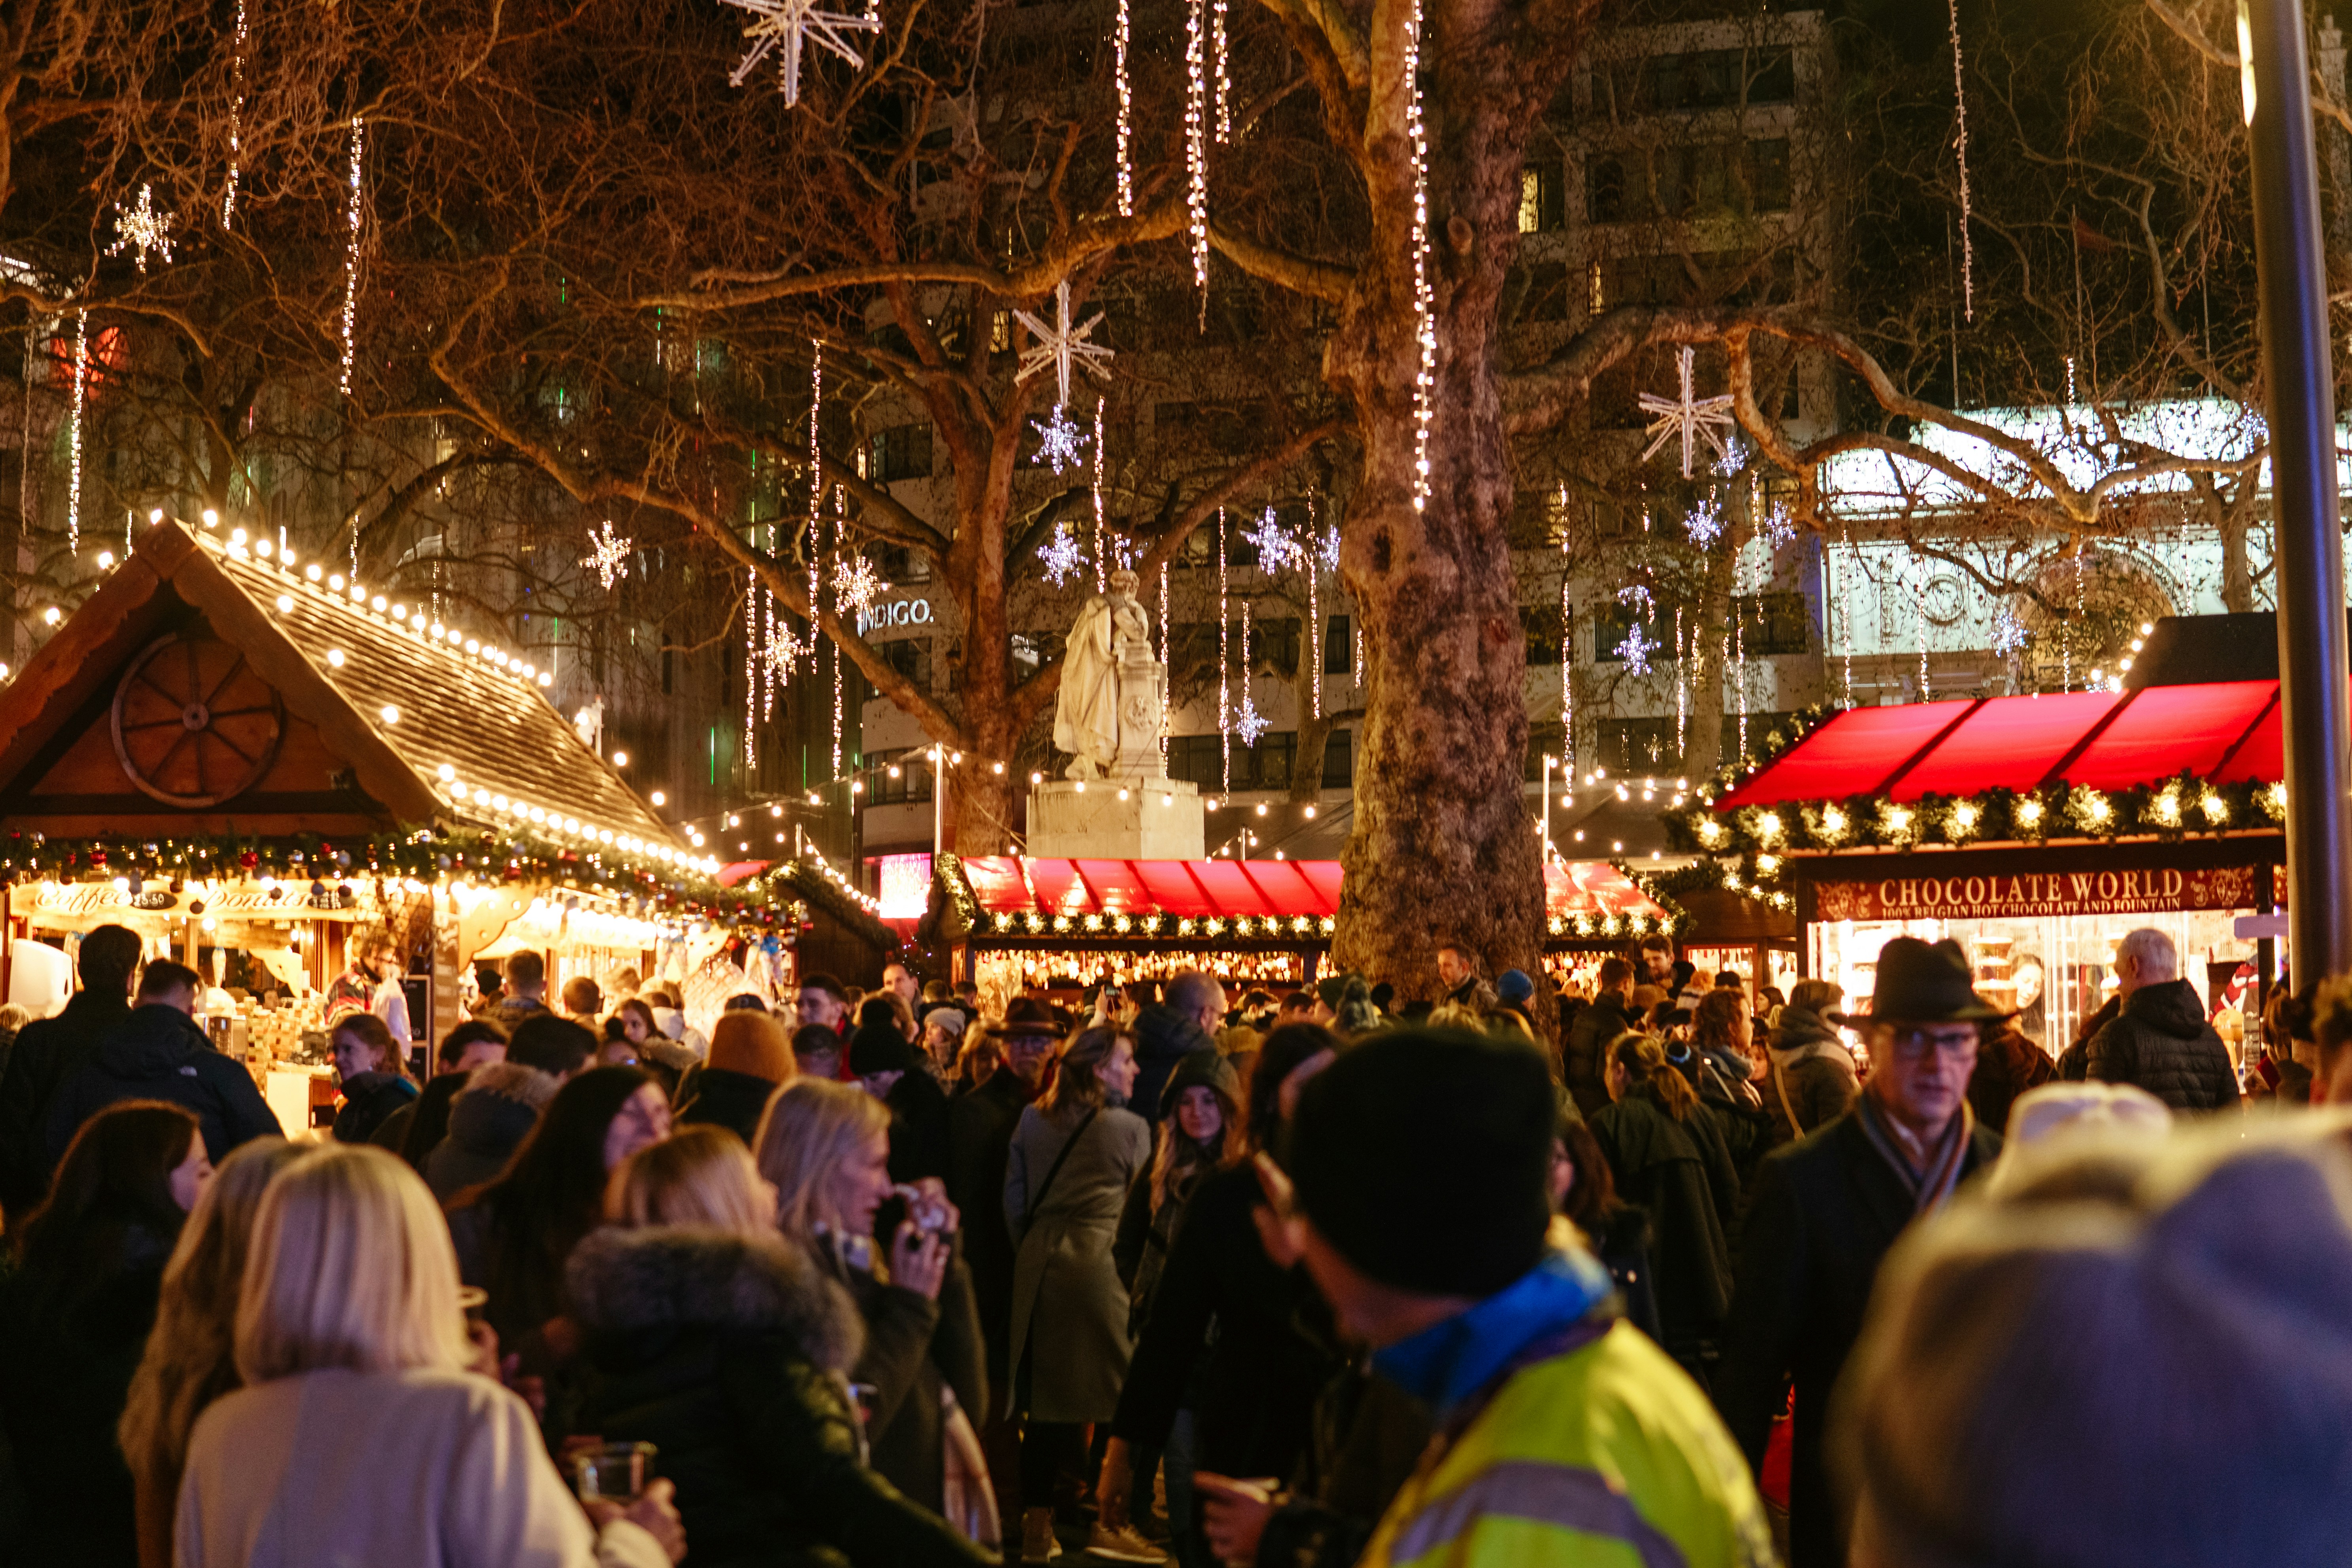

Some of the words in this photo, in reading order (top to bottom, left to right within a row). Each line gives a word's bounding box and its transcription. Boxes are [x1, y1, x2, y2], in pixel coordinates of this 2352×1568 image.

[1879, 873, 2061, 907] CHOCOLATE
[2068, 868, 2182, 900] WORLD
[1883, 907, 1911, 919] 100%
[1914, 905, 1968, 919] BELGIAN
[1972, 904, 1999, 917] HOT
[2001, 901, 2078, 916] CHOCOLATE
[2084, 900, 2110, 914] AND
[2114, 898, 2180, 913] FOUNTAIN
